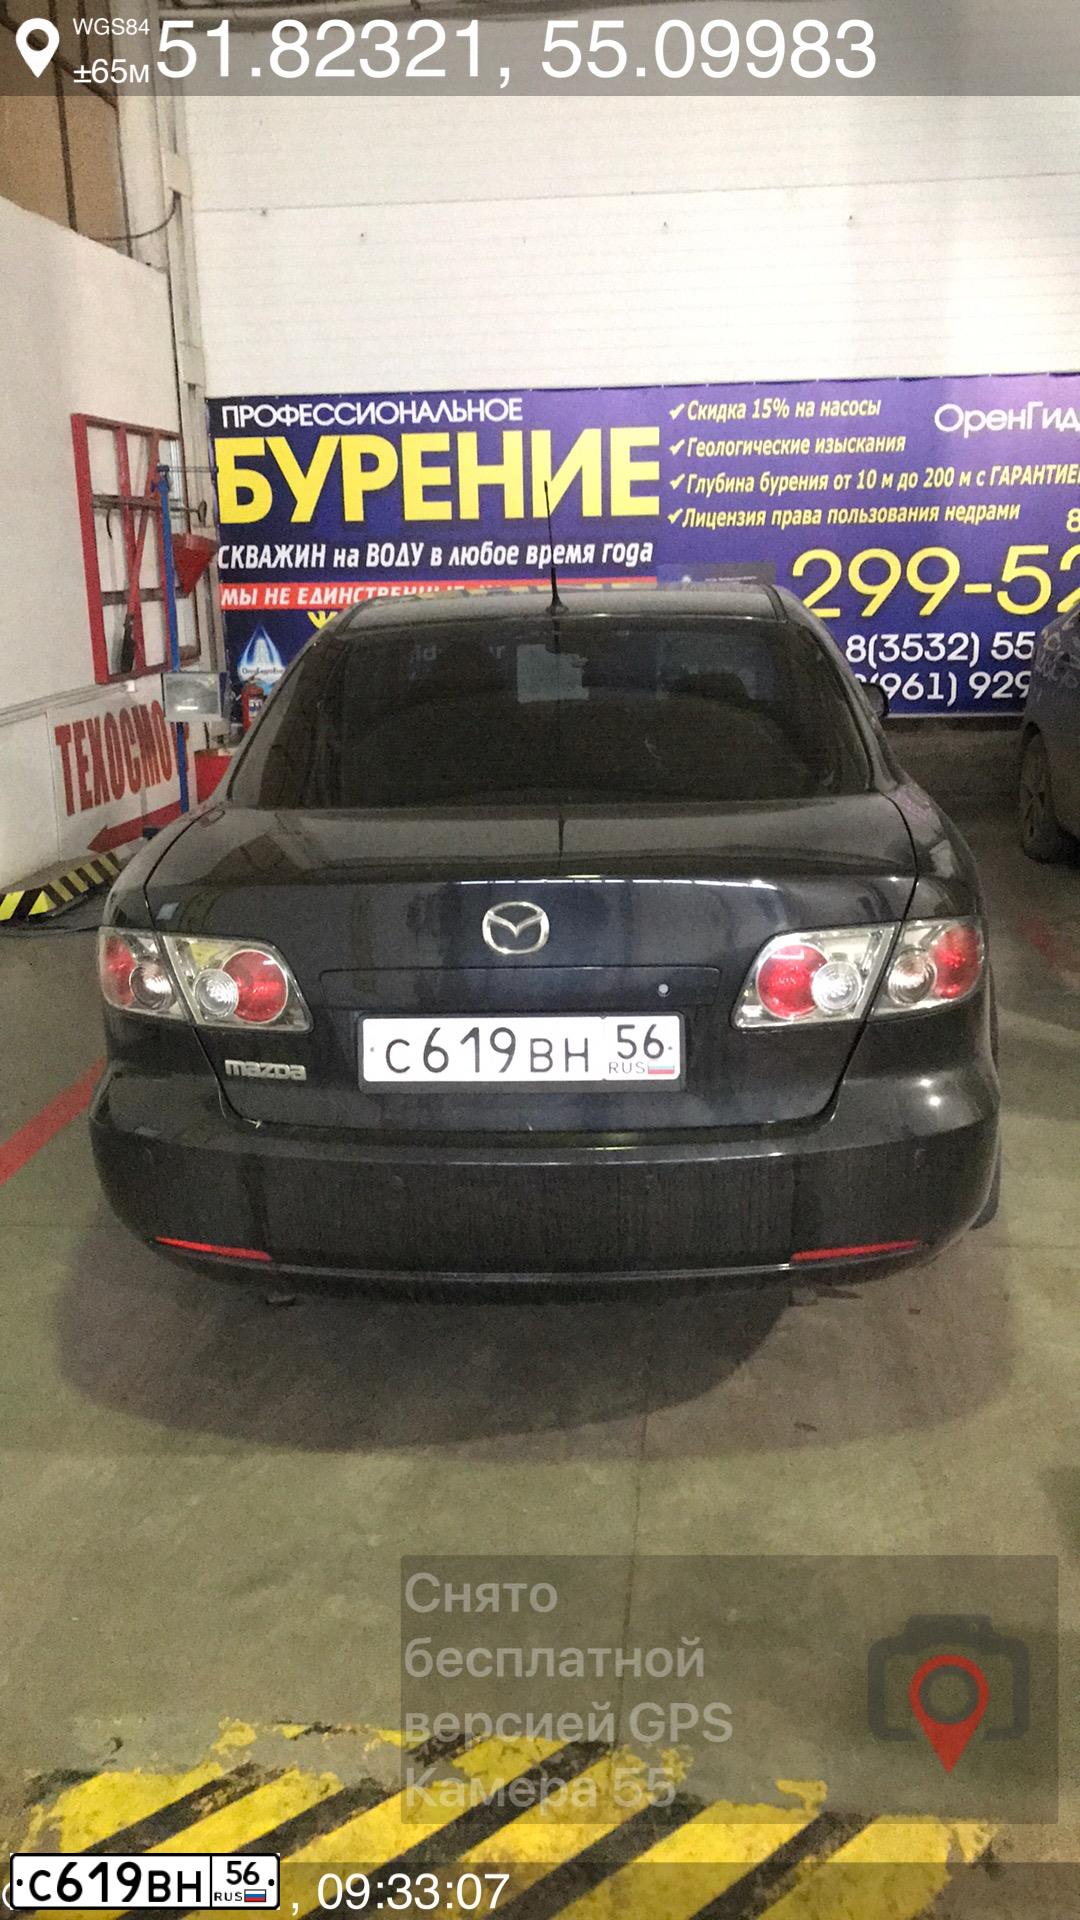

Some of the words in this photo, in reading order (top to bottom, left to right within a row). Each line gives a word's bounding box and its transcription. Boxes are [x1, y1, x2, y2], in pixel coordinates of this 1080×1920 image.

[222, 397, 523, 429] ПРОФЕССИОНАЛЬНОЕ
[687, 399, 746, 423] Скидка
[752, 397, 790, 420] 15%
[795, 400, 815, 418] на
[820, 399, 881, 417] насосы
[687, 432, 811, 458] Геологические
[815, 435, 907, 454] изыскания
[214, 426, 661, 524] БУРЕНИЕ
[686, 471, 755, 498] Глубина
[759, 470, 829, 497] бурения
[833, 472, 852, 490] от
[856, 468, 878, 490] 10
[881, 472, 894, 489] м
[897, 471, 919, 492] до
[923, 466, 956, 489] 200
[959, 469, 972, 487] м
[976, 469, 986, 487] с
[989, 463, 1080, 487] ГАРАНТИЕ
[682, 507, 767, 530] Лицензия
[771, 507, 823, 530] права
[827, 504, 940, 526] пользования
[944, 503, 1021, 526] недрами
[217, 542, 326, 570] СКВАЖИН
[333, 545, 360, 569] на
[365, 542, 425, 569] ВОДУ
[430, 545, 443, 567] в
[449, 540, 520, 567] любое
[526, 544, 595, 572] время
[601, 541, 654, 567] года
[220, 587, 258, 607] МЫ
[264, 587, 292, 606] НЕ
[296, 584, 465, 605] ЕДИНСТВЕН
[845, 631, 980, 670] 8(3532)
[854, 671, 958, 707] 961)
[54, 700, 190, 817] ТЕХОСМО
[385, 1026, 590, 1073] С619ВН
[616, 1023, 664, 1059] 56
[607, 1061, 646, 1074] RUS
